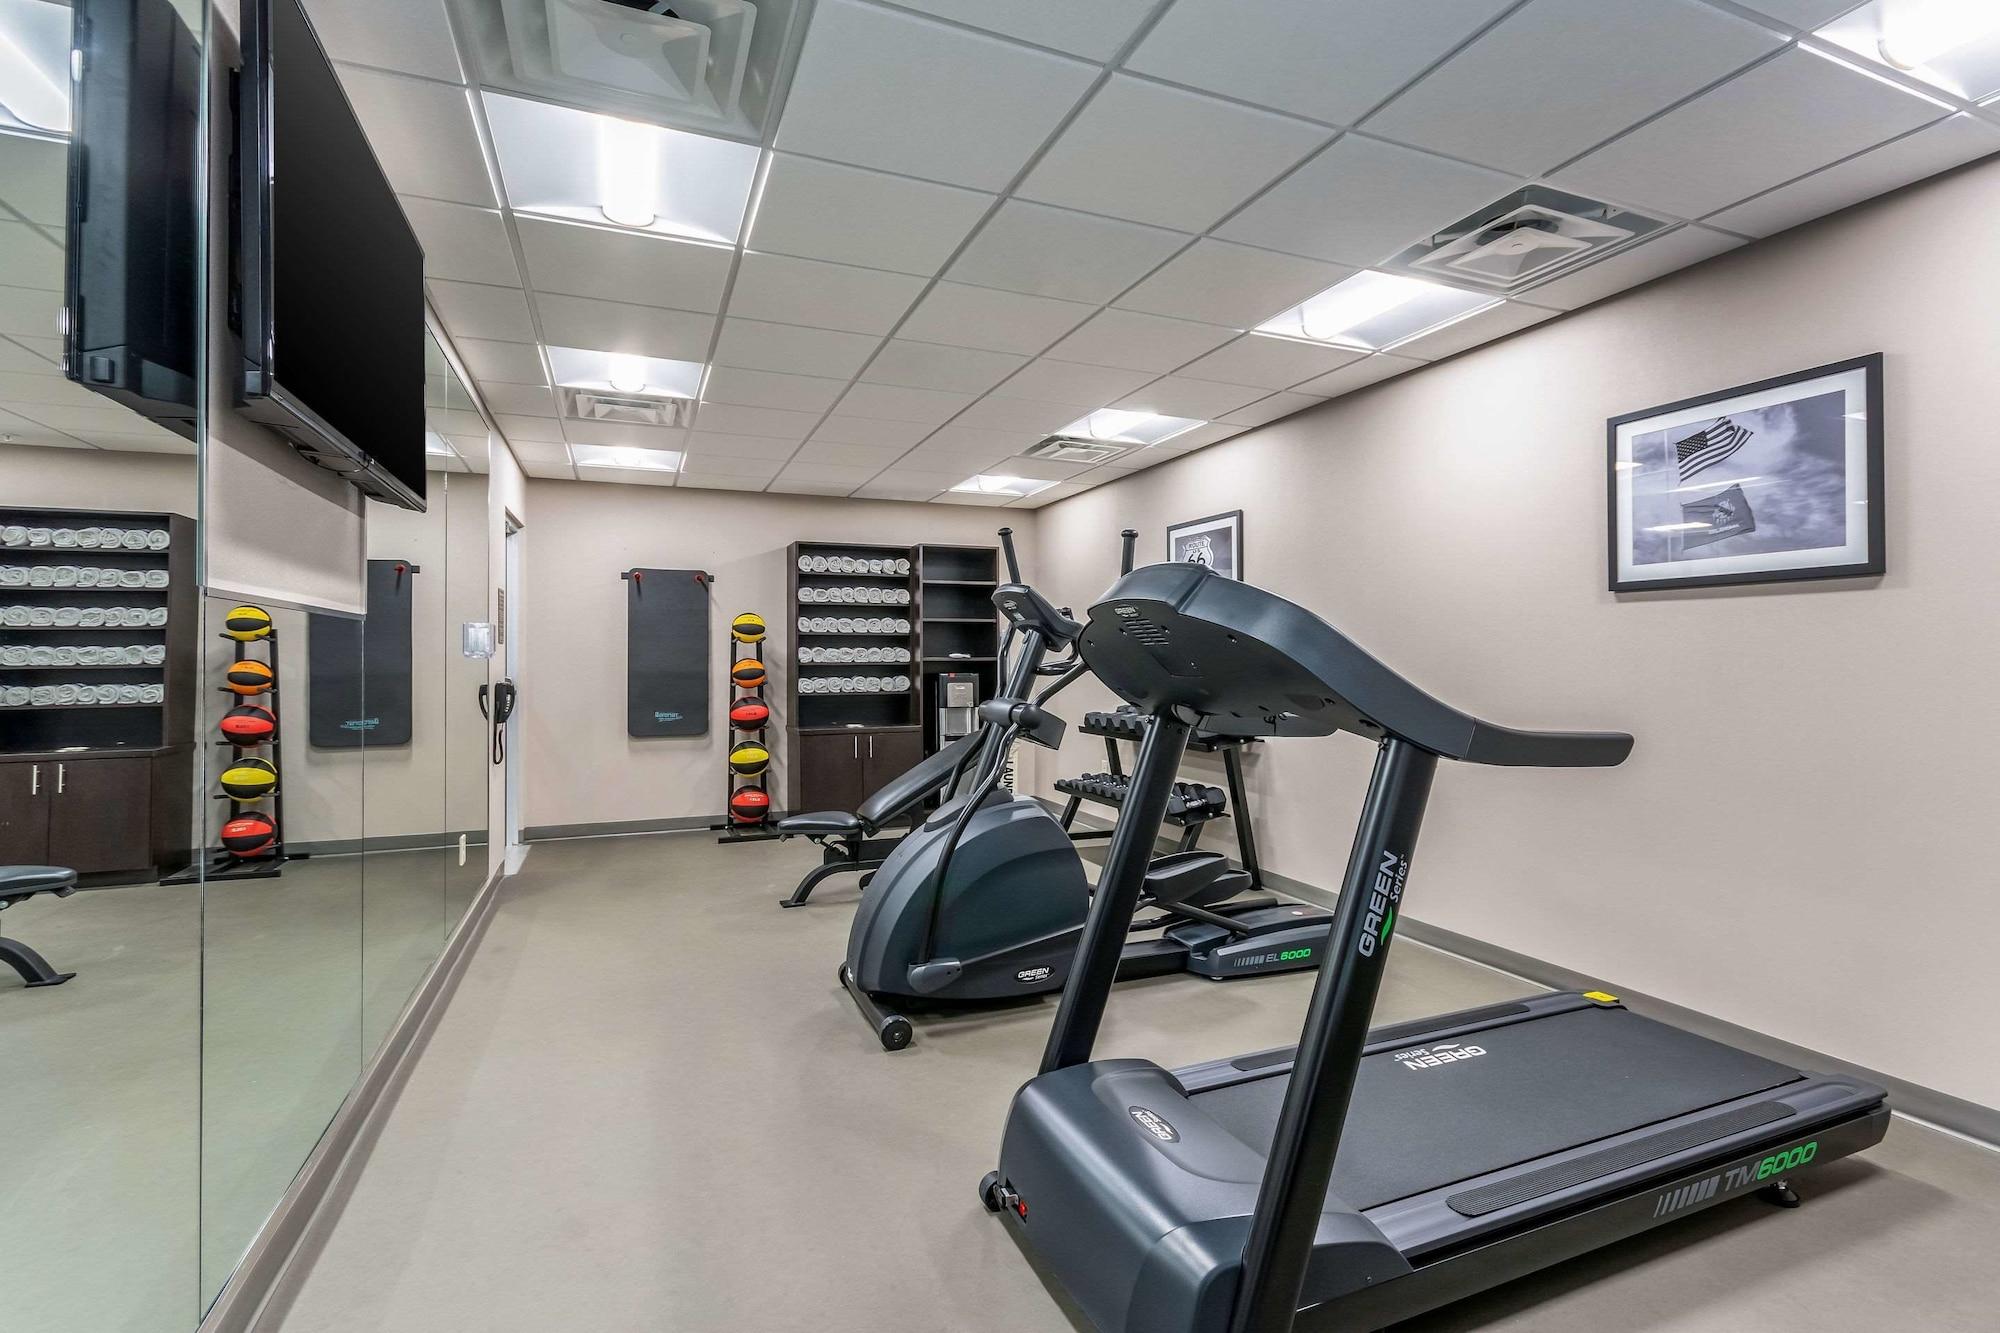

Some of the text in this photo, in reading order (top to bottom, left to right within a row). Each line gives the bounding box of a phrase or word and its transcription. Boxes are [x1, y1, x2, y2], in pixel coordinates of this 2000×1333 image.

[1389, 861, 1408, 903] Series
[1358, 850, 1398, 957] GREEN
[1265, 948, 1311, 963] EL6000
[1017, 967, 1050, 979] GREEN
[1403, 1045, 1487, 1071] GREEN
[1131, 1111, 1173, 1140] GREEN
[1725, 1141, 1818, 1192] TM6000
